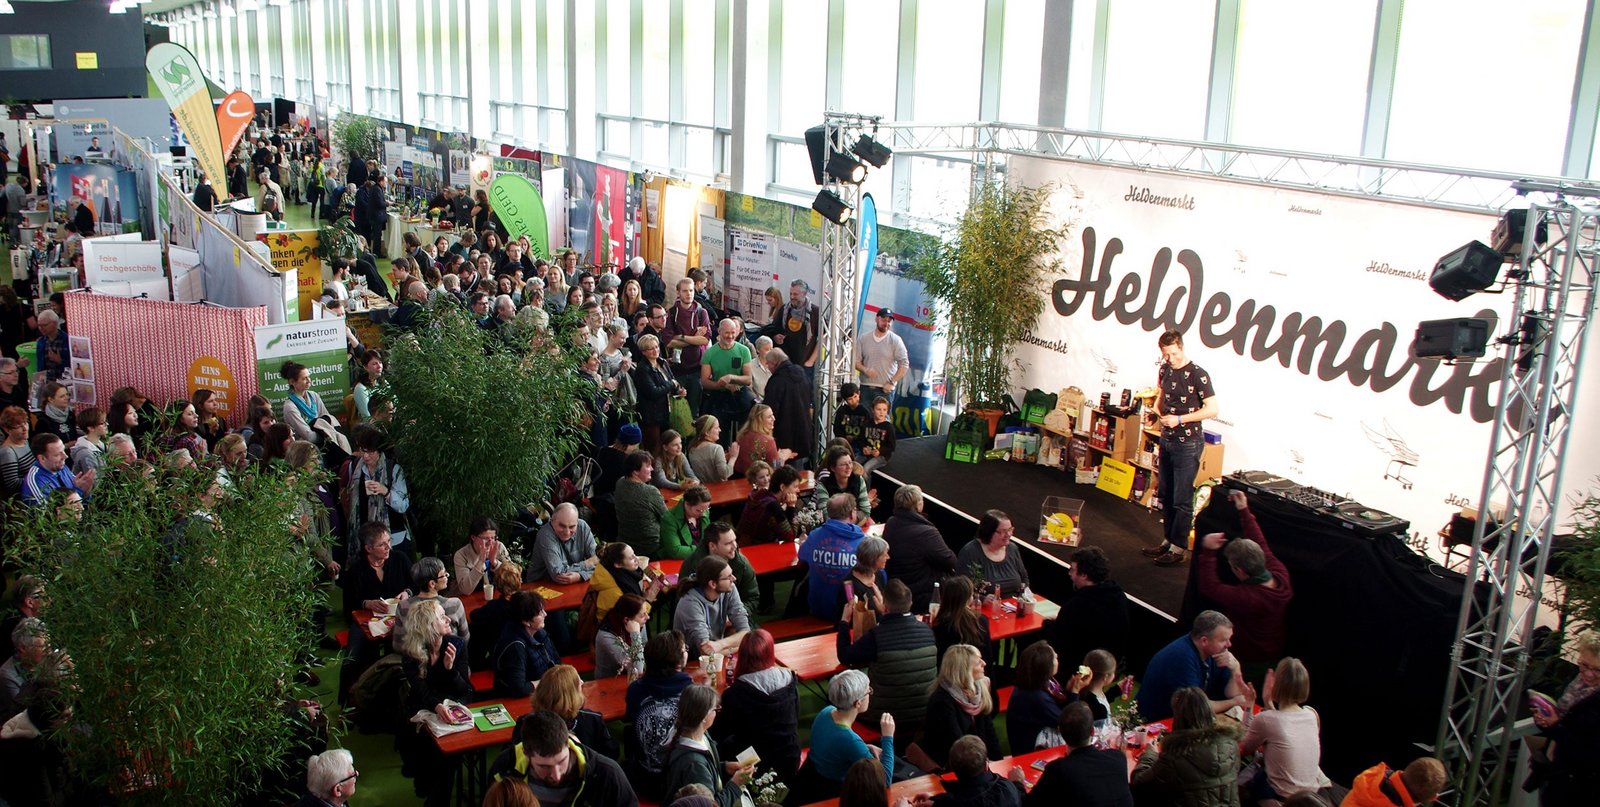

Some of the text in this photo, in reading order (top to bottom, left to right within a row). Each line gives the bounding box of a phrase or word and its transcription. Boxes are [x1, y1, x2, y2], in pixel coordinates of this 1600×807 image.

[1124, 185, 1195, 210] Heldenmarkt
[743, 239, 767, 250] DriveNow
[270, 250, 295, 258] inken
[292, 258, 304, 267] die
[1366, 260, 1427, 281] Heldenmarkt
[287, 328, 338, 341] naturstrom
[201, 366, 220, 375] EINS
[194, 376, 229, 388] MIT DEM
[264, 372, 281, 381] Ihre
[813, 549, 858, 567] CYCLING
